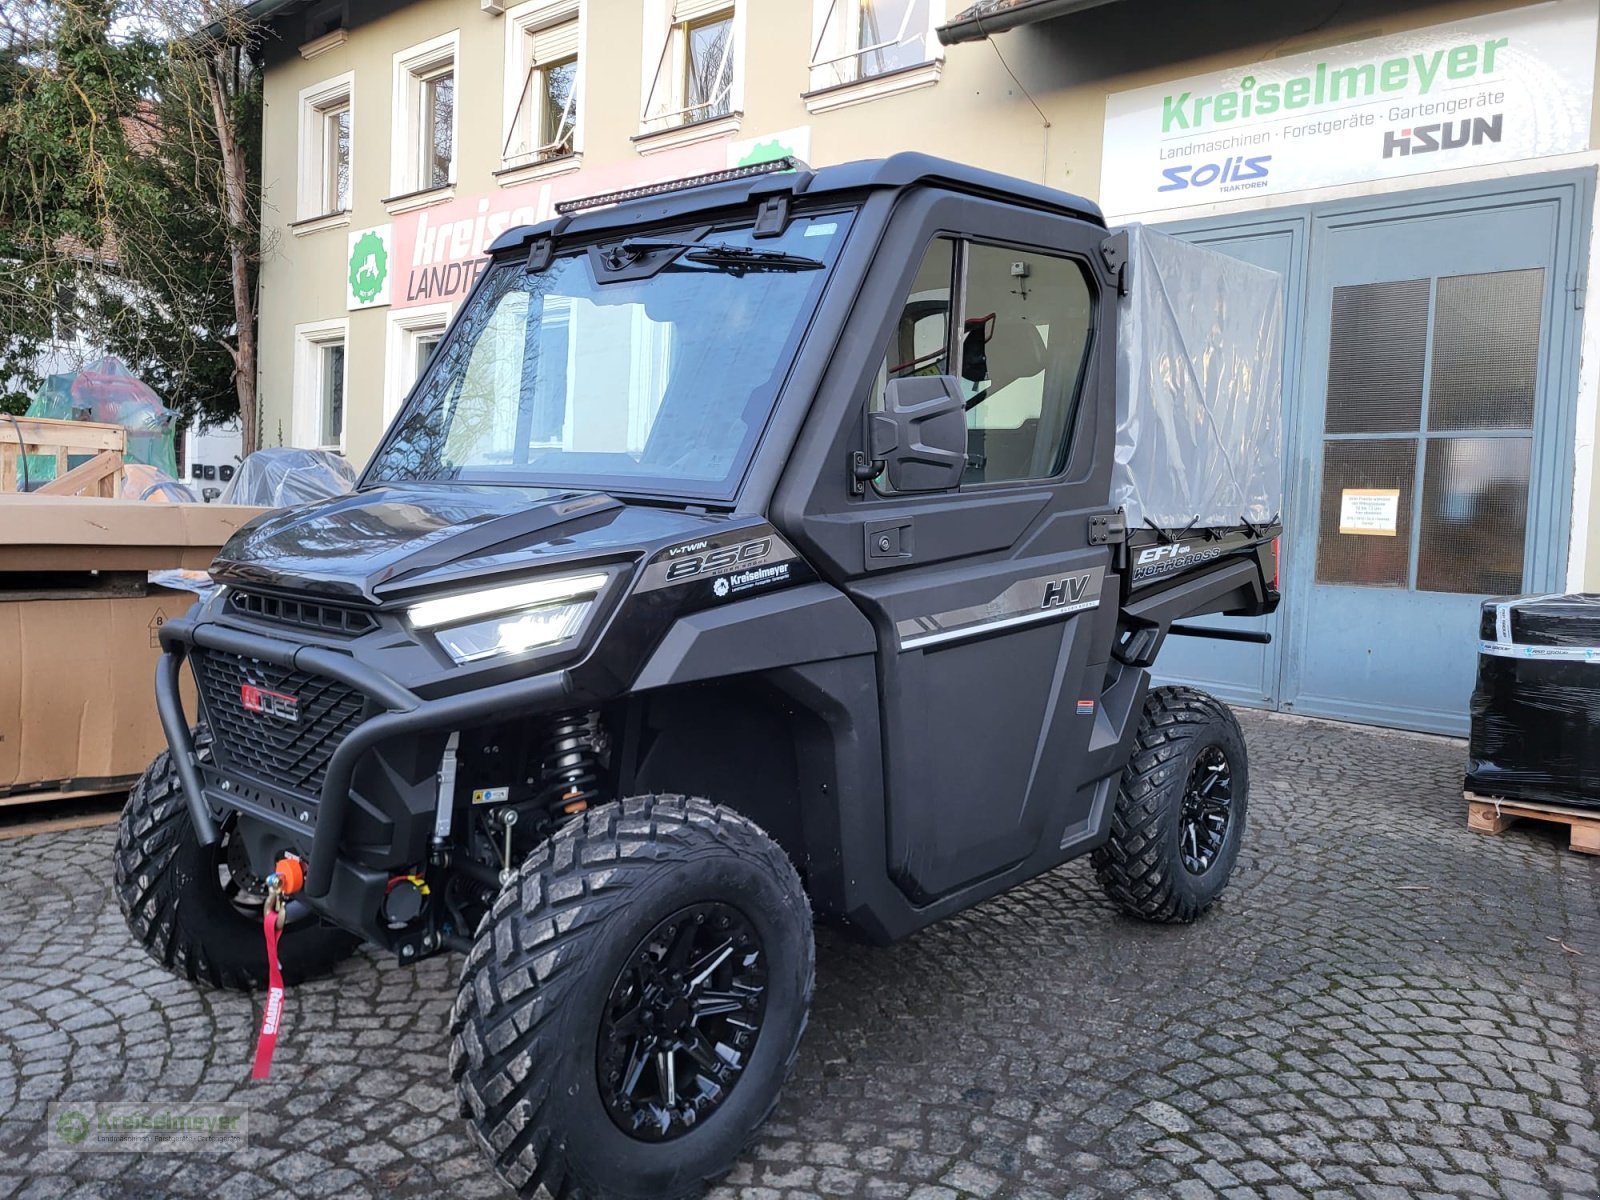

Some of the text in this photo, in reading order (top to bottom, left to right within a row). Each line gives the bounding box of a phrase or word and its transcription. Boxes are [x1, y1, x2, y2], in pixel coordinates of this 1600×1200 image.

[1161, 37, 1509, 133] Kreiselmeyer
[1159, 91, 1505, 160] Landmaschinen Forstgeräte Gartengeräte
[1219, 180, 1268, 193] TRAKTOREN
[665, 537, 772, 582] 850
[669, 541, 708, 556] V-TWIN
[1138, 543, 1180, 564] EFI
[730, 563, 789, 586] Kreiselmeyer
[1041, 574, 1091, 609] HV
